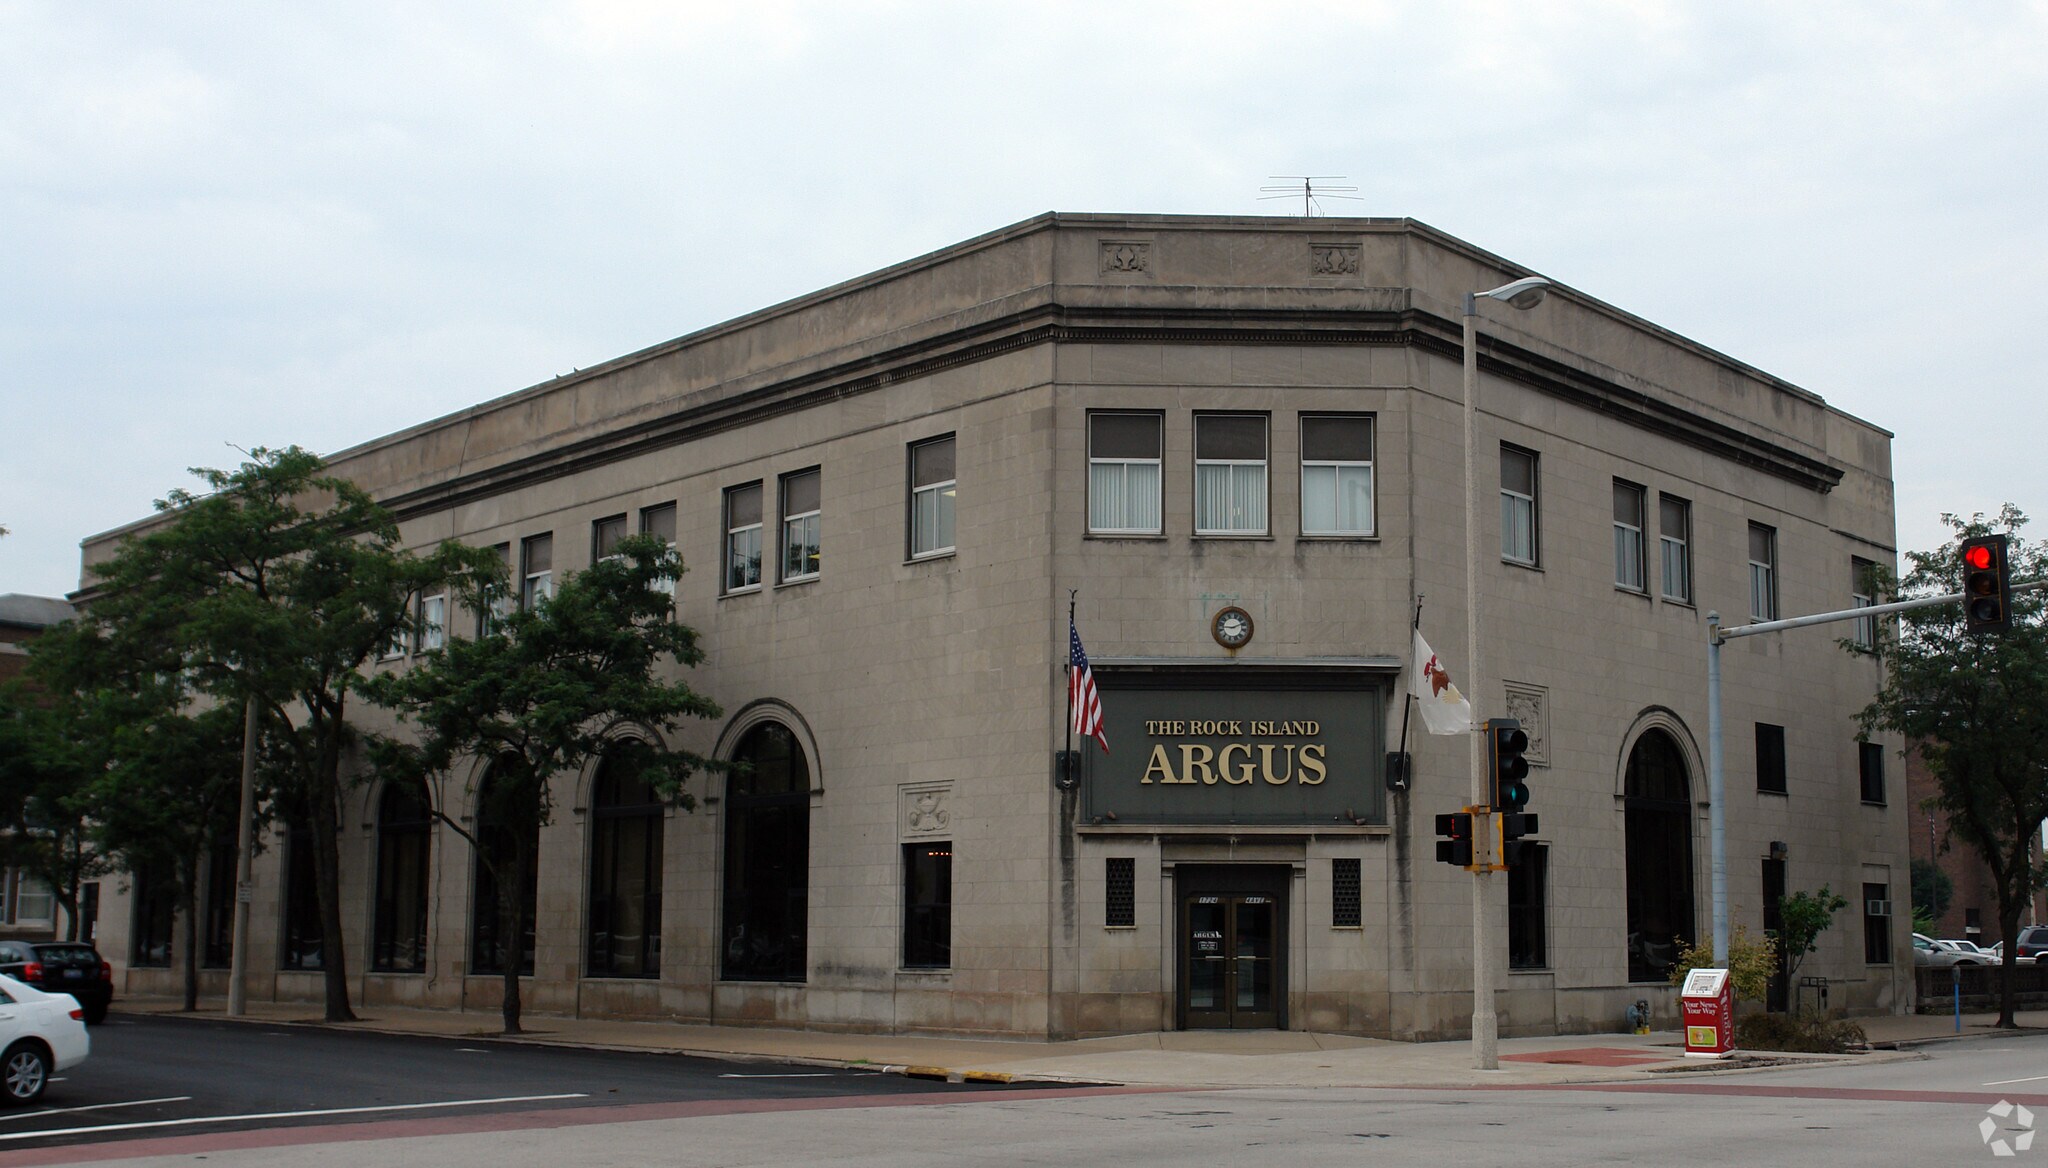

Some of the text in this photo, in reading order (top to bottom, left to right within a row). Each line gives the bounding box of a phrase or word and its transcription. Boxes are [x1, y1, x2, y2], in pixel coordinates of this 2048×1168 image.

[1146, 720, 1320, 736] THE ROCK ISLAND
[1141, 743, 1327, 785] ARGUS
[1687, 1007, 1701, 1015] Your
[1723, 1004, 1732, 1049] Argus
